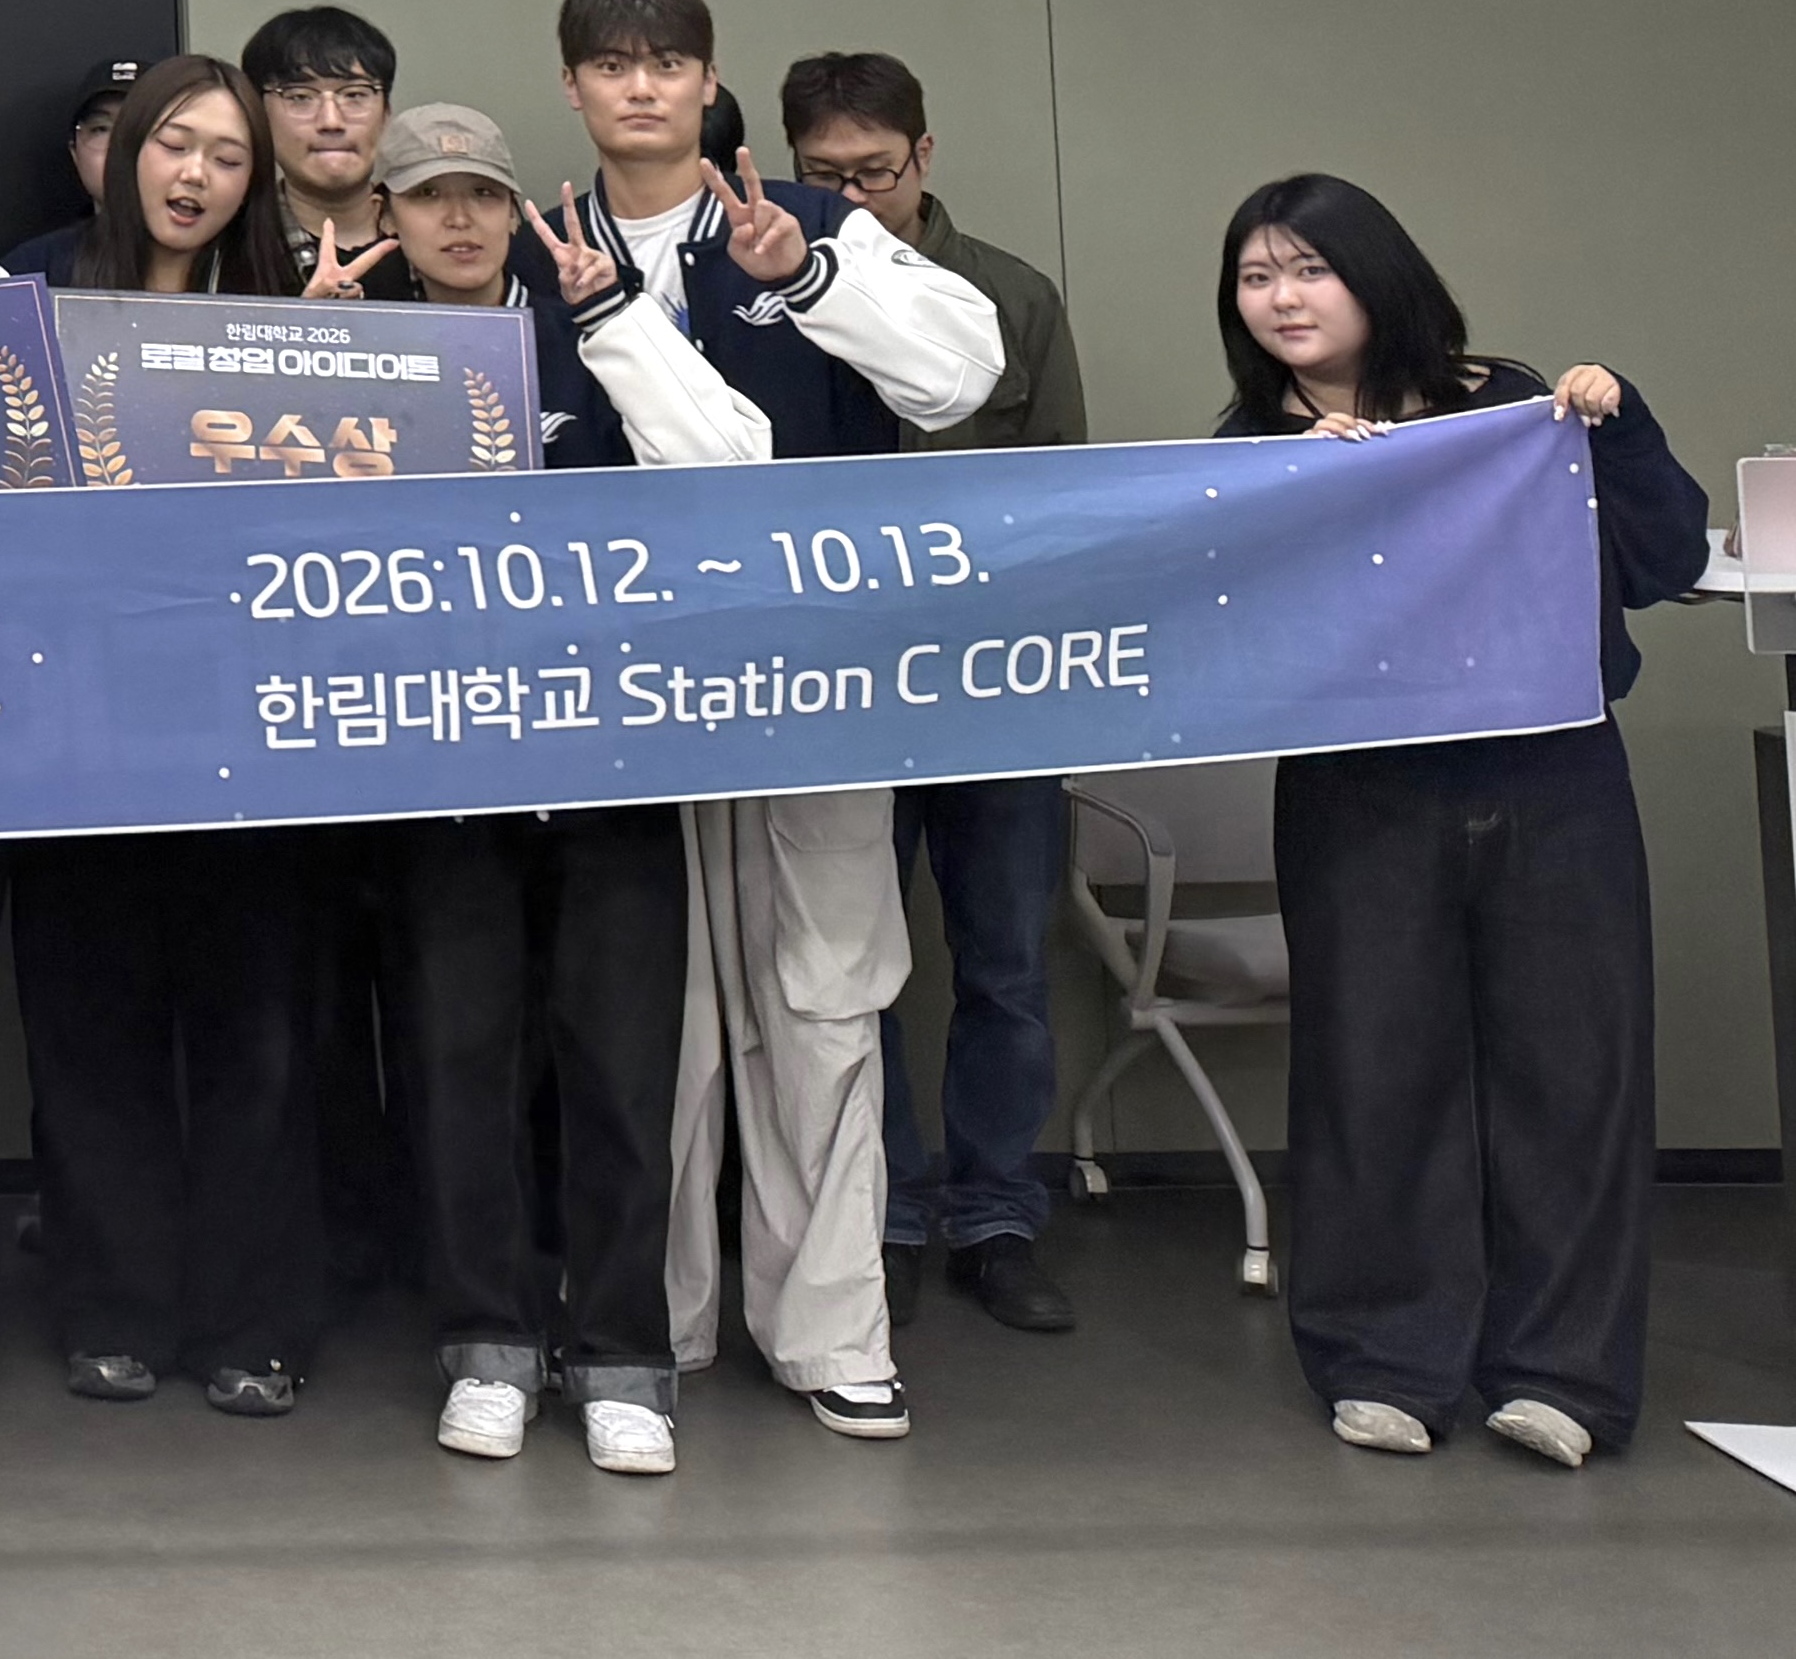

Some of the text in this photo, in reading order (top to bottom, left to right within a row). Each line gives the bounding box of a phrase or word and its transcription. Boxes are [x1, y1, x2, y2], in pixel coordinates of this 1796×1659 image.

[141, 343, 440, 382] 로컬 창업 아이디어톤
[226, 323, 350, 344] 한림대학교 2026
[190, 409, 397, 478] 우수상
[246, 538, 674, 619] 2026.10.12.
[771, 523, 989, 595] 10.13.
[255, 624, 1149, 747] 한림대학교 Station C CORE
